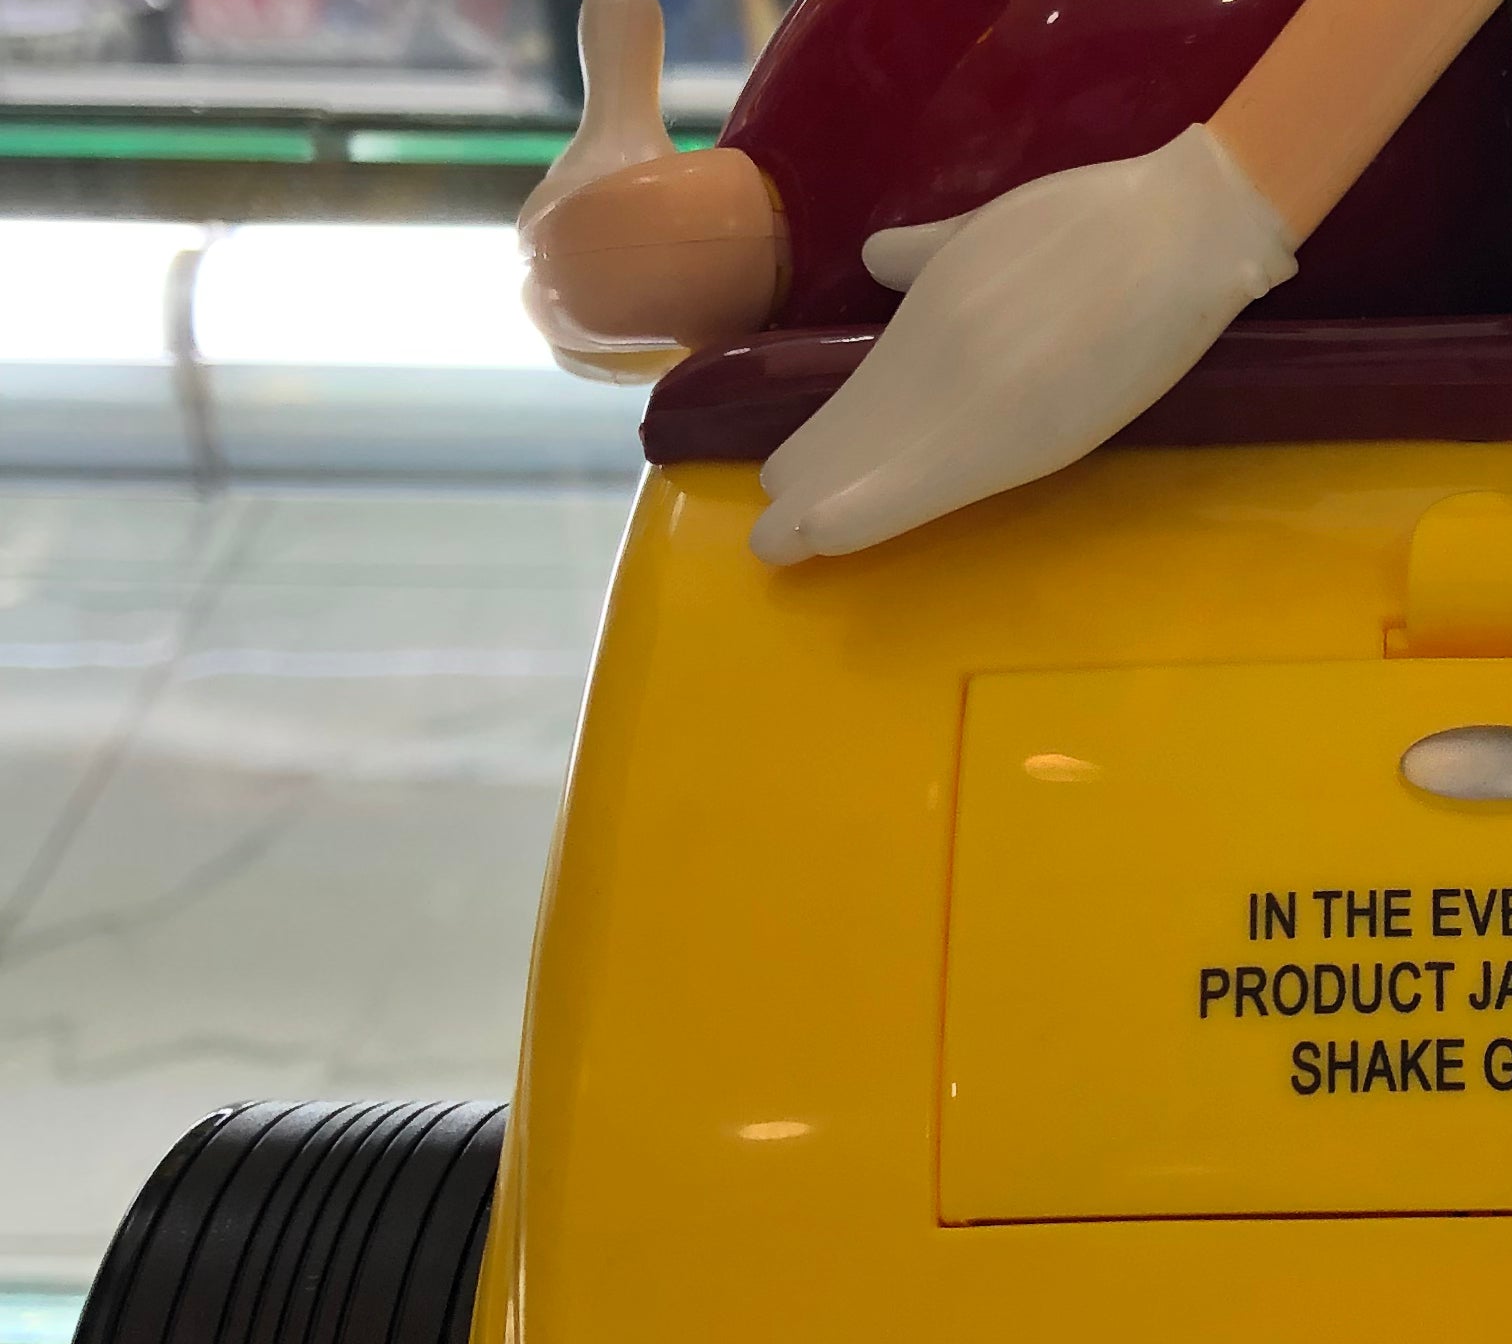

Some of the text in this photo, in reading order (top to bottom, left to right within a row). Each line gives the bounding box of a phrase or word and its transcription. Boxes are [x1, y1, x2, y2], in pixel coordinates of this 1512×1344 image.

[1250, 892, 1296, 940] IN
[1313, 889, 1412, 938] THE
[1200, 961, 1455, 1018] PRODUCT
[1291, 1039, 1465, 1095] SHAKE
